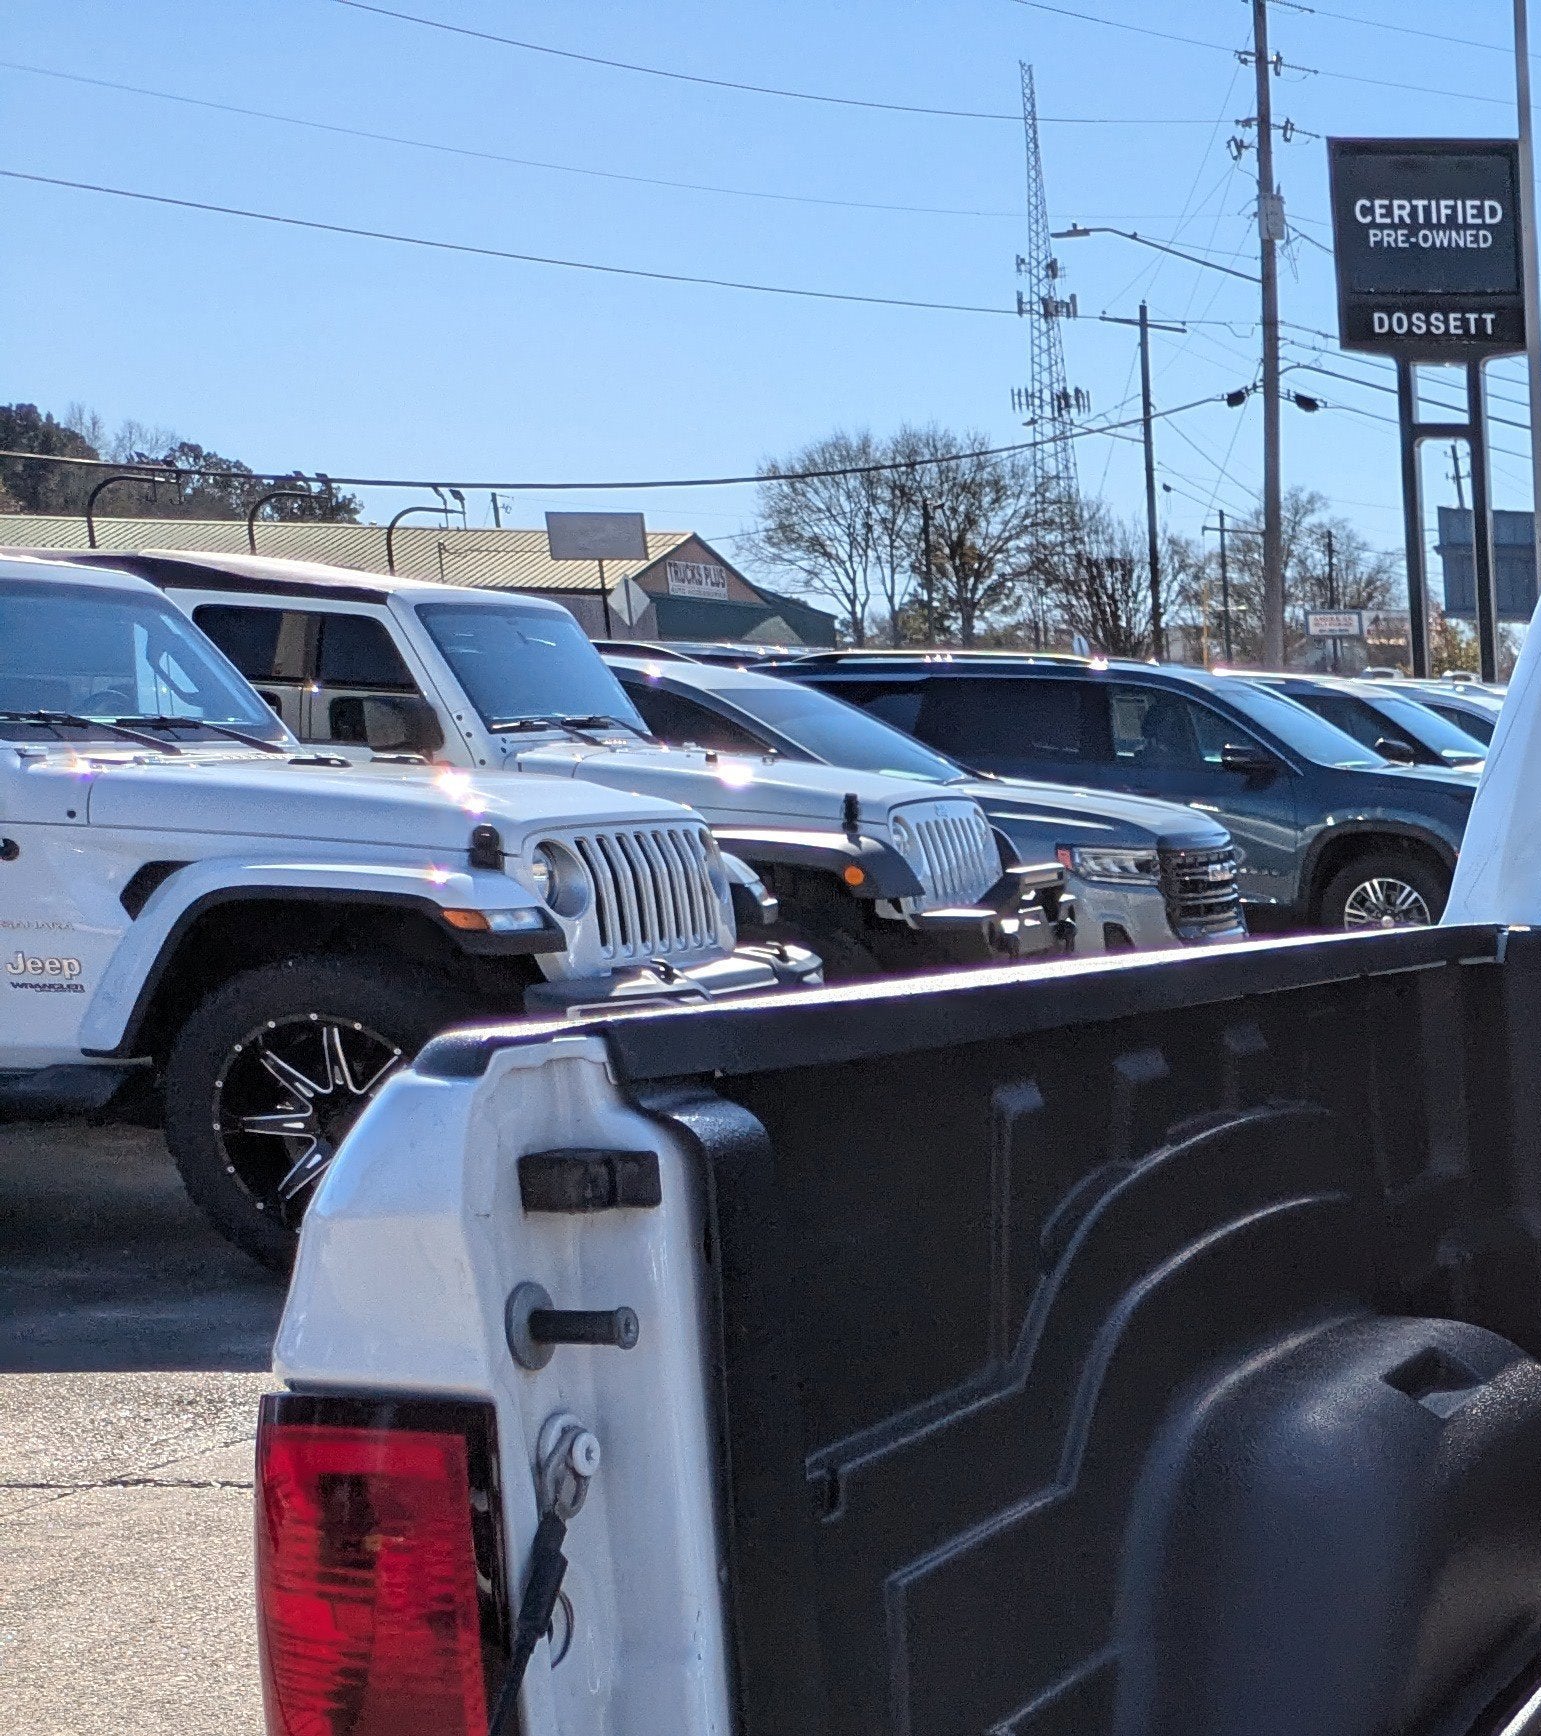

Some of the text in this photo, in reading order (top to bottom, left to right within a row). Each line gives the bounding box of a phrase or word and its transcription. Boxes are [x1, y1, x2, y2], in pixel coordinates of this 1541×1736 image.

[1354, 199, 1503, 225] CERTIFIED
[1369, 229, 1493, 248] PRE-OWNED
[1373, 312, 1496, 335] DOSSETT
[5, 950, 82, 981] Jeep
